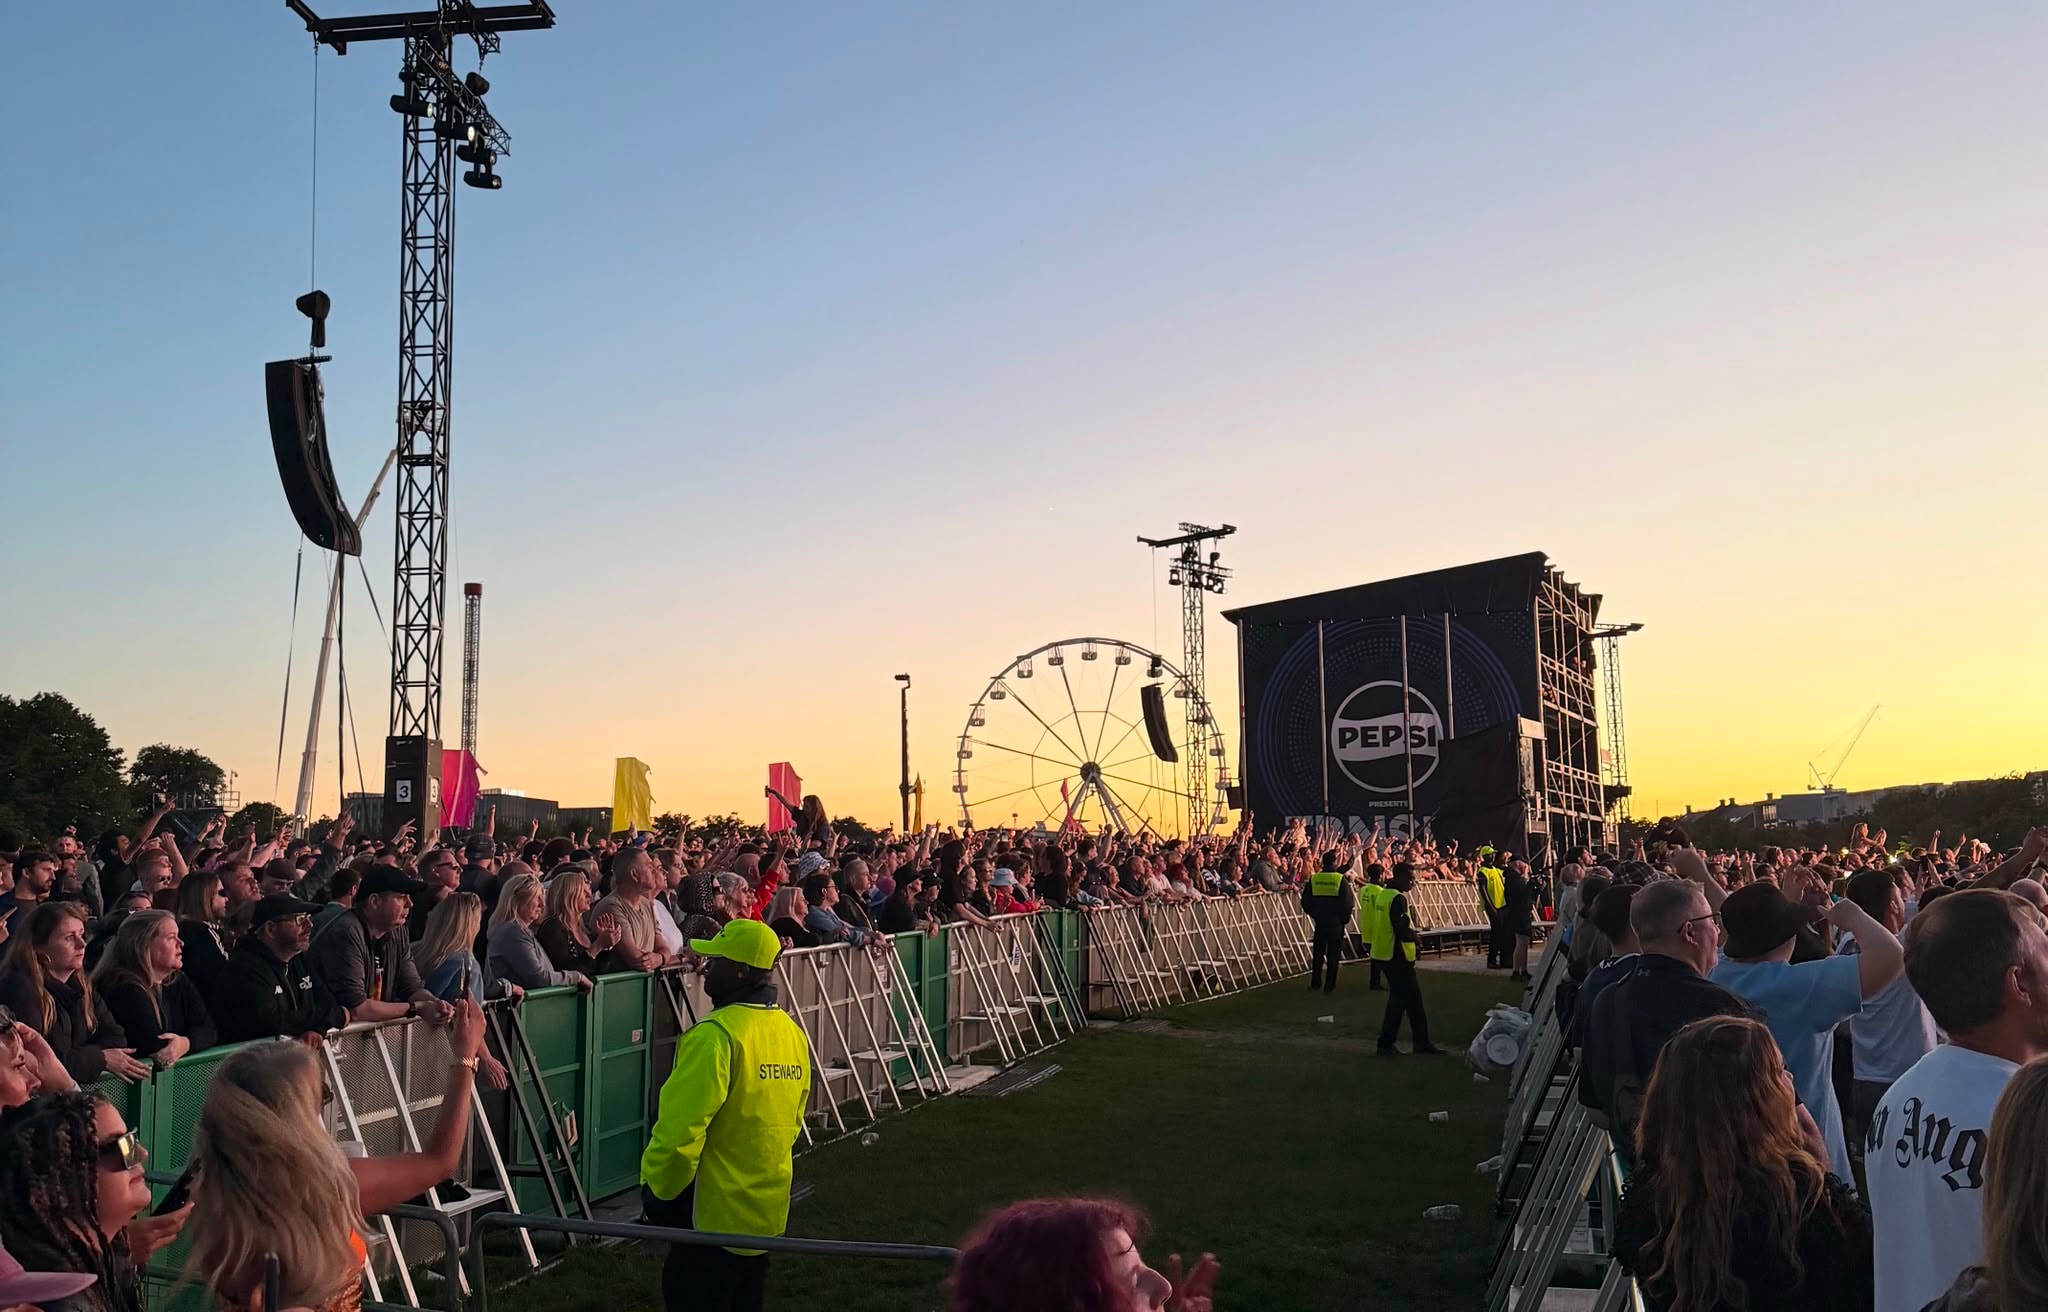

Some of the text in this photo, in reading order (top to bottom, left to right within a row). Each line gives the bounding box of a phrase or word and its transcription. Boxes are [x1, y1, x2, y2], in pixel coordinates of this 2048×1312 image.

[1339, 725, 1436, 749] PEPSI
[400, 785, 409, 798] 3
[759, 1063, 802, 1080] STEWARD
[1895, 1097, 1988, 1192] Ang
